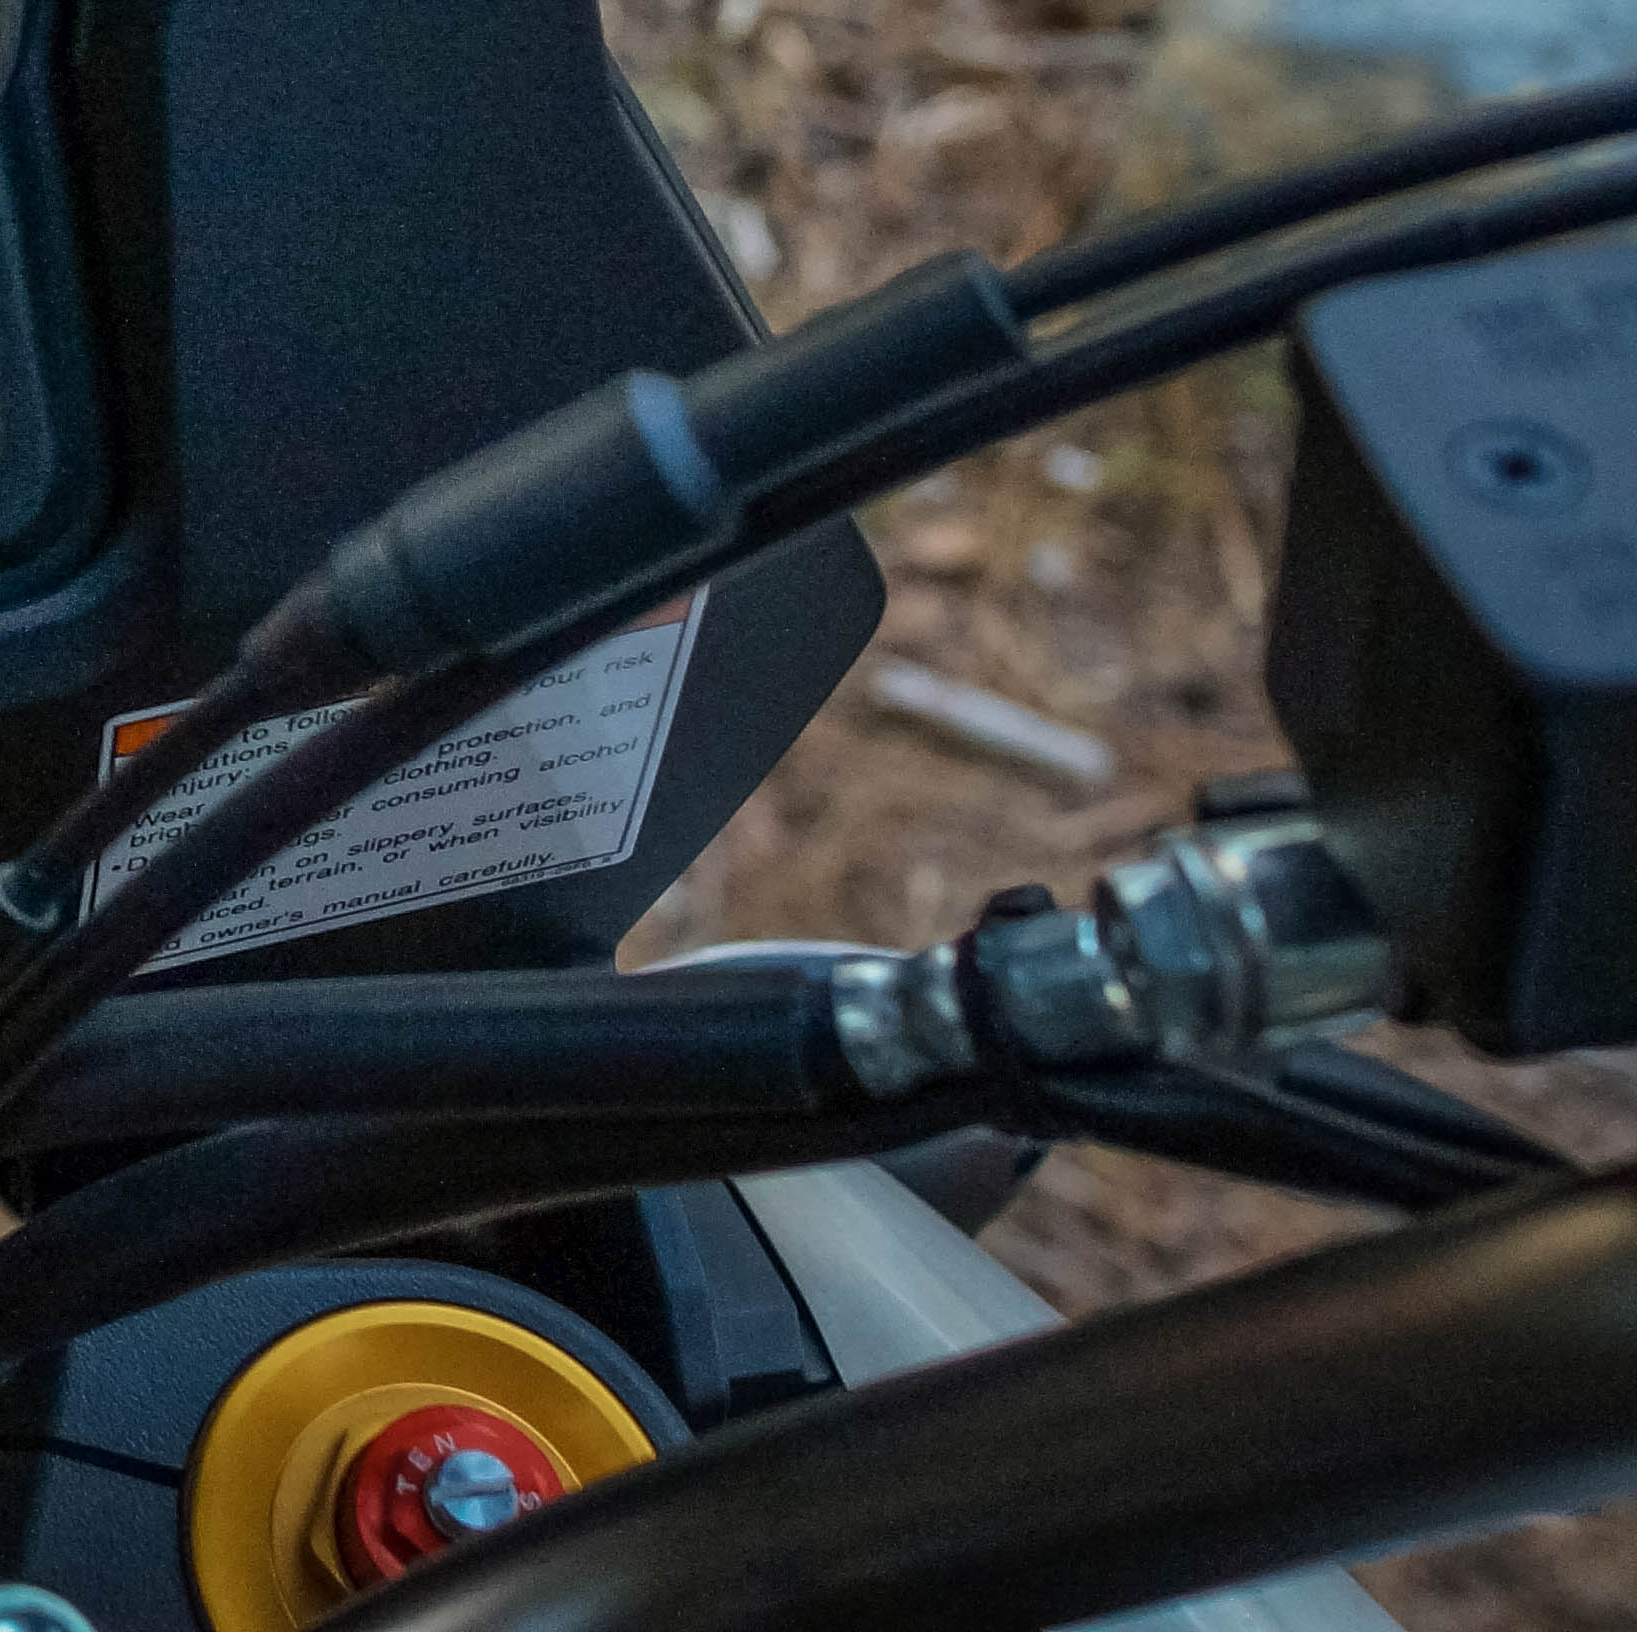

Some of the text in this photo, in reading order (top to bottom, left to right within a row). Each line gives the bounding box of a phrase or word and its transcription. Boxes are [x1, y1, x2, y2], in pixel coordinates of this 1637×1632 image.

[242, 728, 270, 743] to
[604, 650, 654, 674] risk
[599, 692, 652, 718] and
[197, 740, 290, 772] utions
[371, 735, 639, 812] consuming alcohol
[384, 750, 498, 785] clothing.
[295, 852, 328, 868] on
[347, 821, 454, 857] slippery
[382, 848, 410, 864] or
[428, 827, 499, 854] when
[519, 798, 625, 831] visibility
[200, 908, 304, 944] owner's
[322, 879, 422, 916] manual
[437, 850, 557, 889] carefully.
